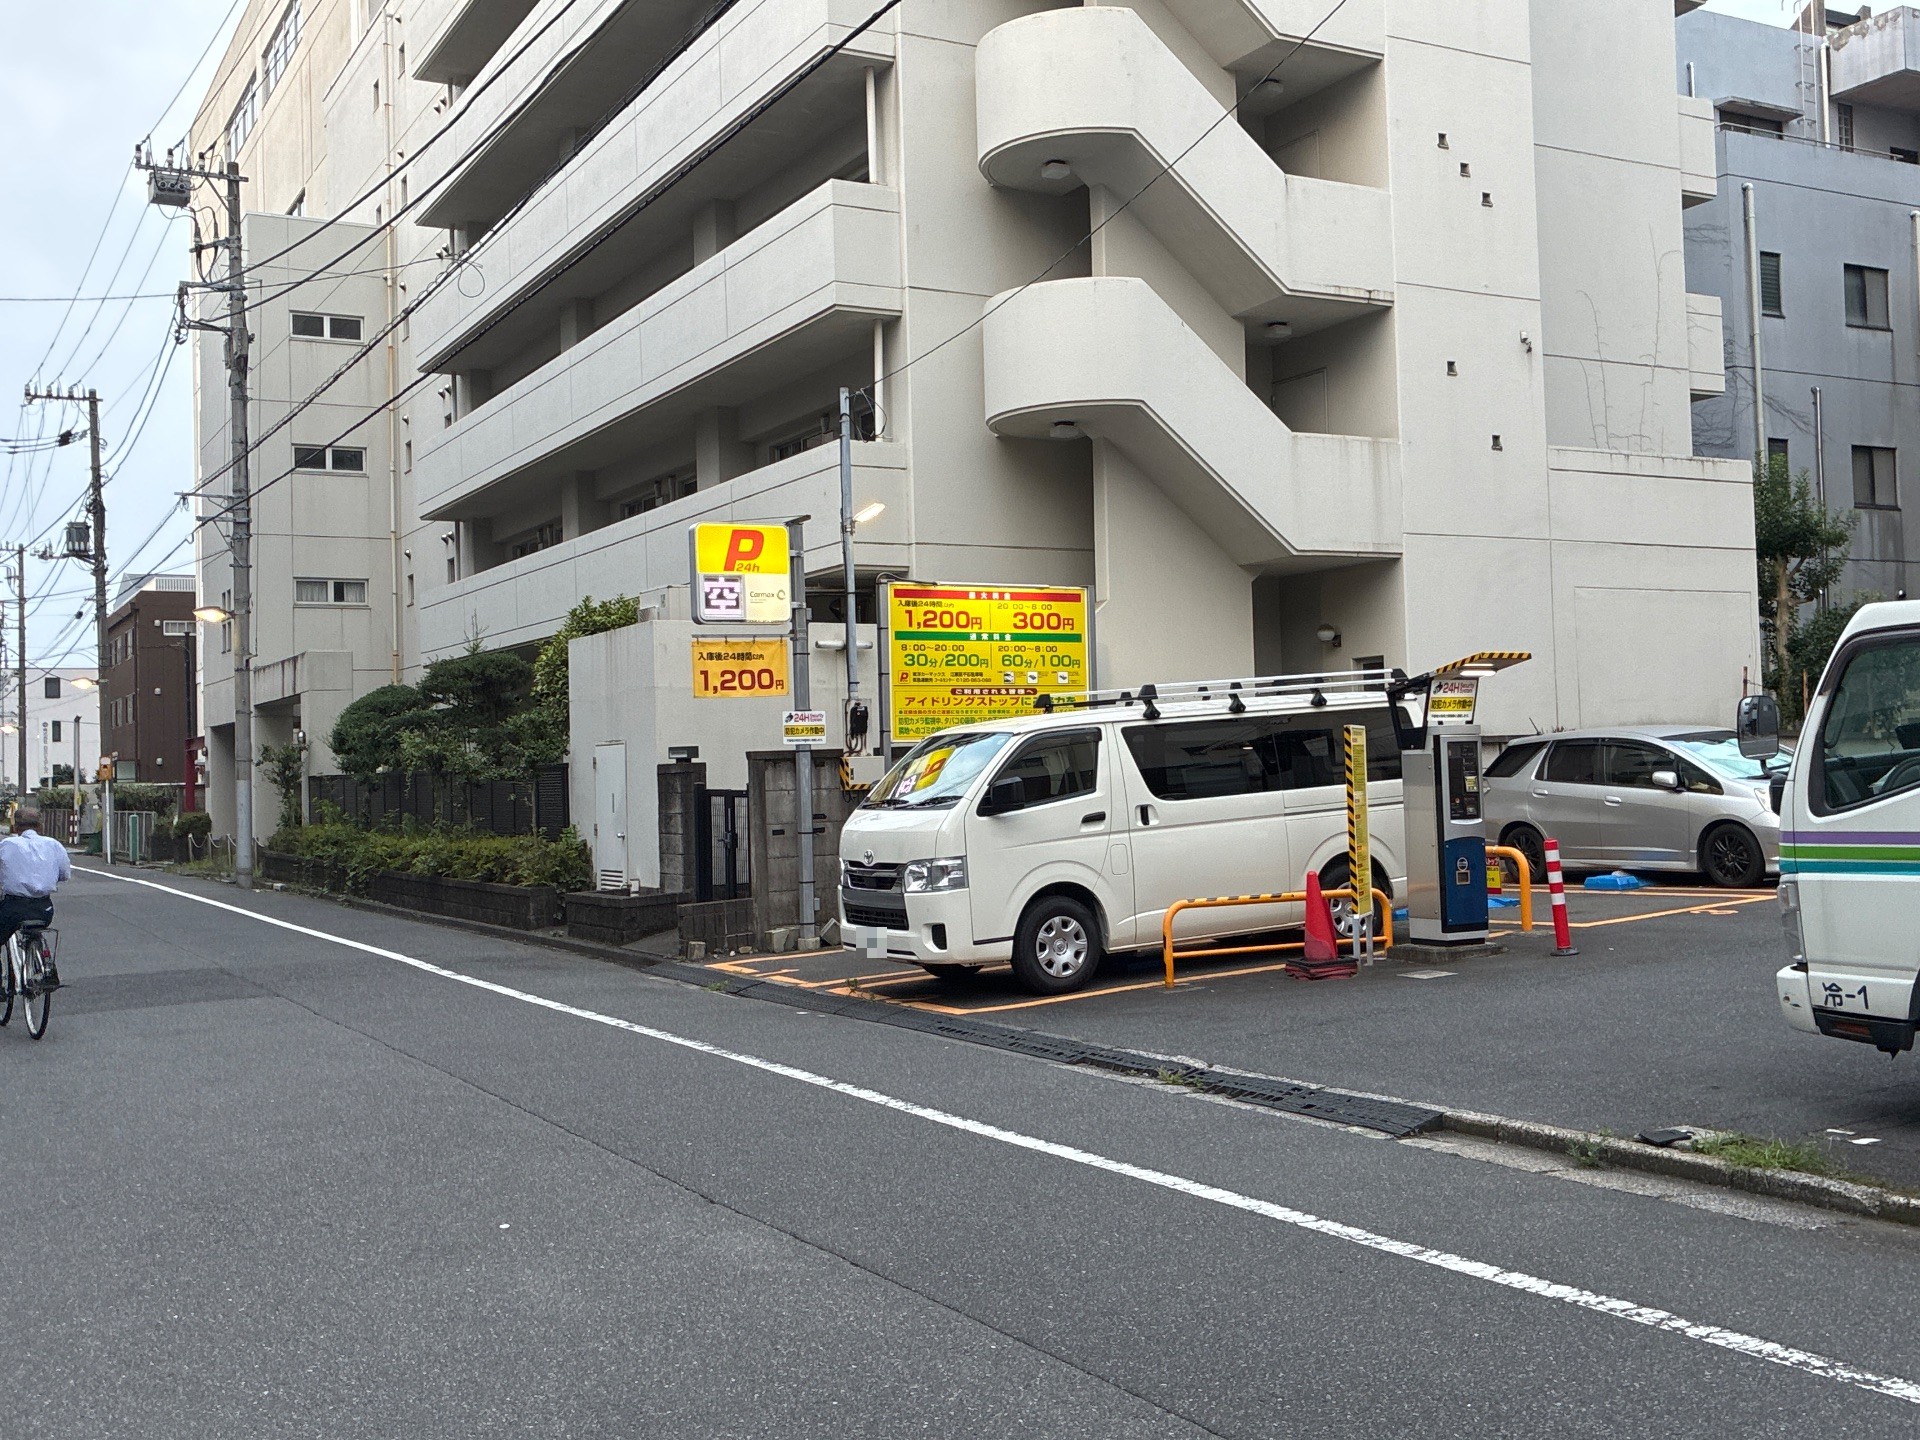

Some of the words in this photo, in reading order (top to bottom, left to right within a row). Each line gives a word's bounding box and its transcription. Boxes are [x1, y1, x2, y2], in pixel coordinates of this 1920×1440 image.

[723, 529, 765, 572] P
[736, 562, 760, 573] 24h
[904, 609, 983, 630] 1,200円
[1012, 612, 1075, 631] 300円
[697, 651, 765, 661] 入庫後24時間以内
[903, 653, 989, 668] 30分/200円
[1001, 654, 1081, 669] 60分/100円
[699, 668, 785, 694] 1,200円
[1442, 682, 1460, 694] 24H
[1430, 699, 1473, 710] 防犯カメラ作動中
[793, 713, 810, 723] 24H
[784, 726, 825, 736] 防犯カメラ作動中
[1821, 981, 1869, 1010] 冷-1
